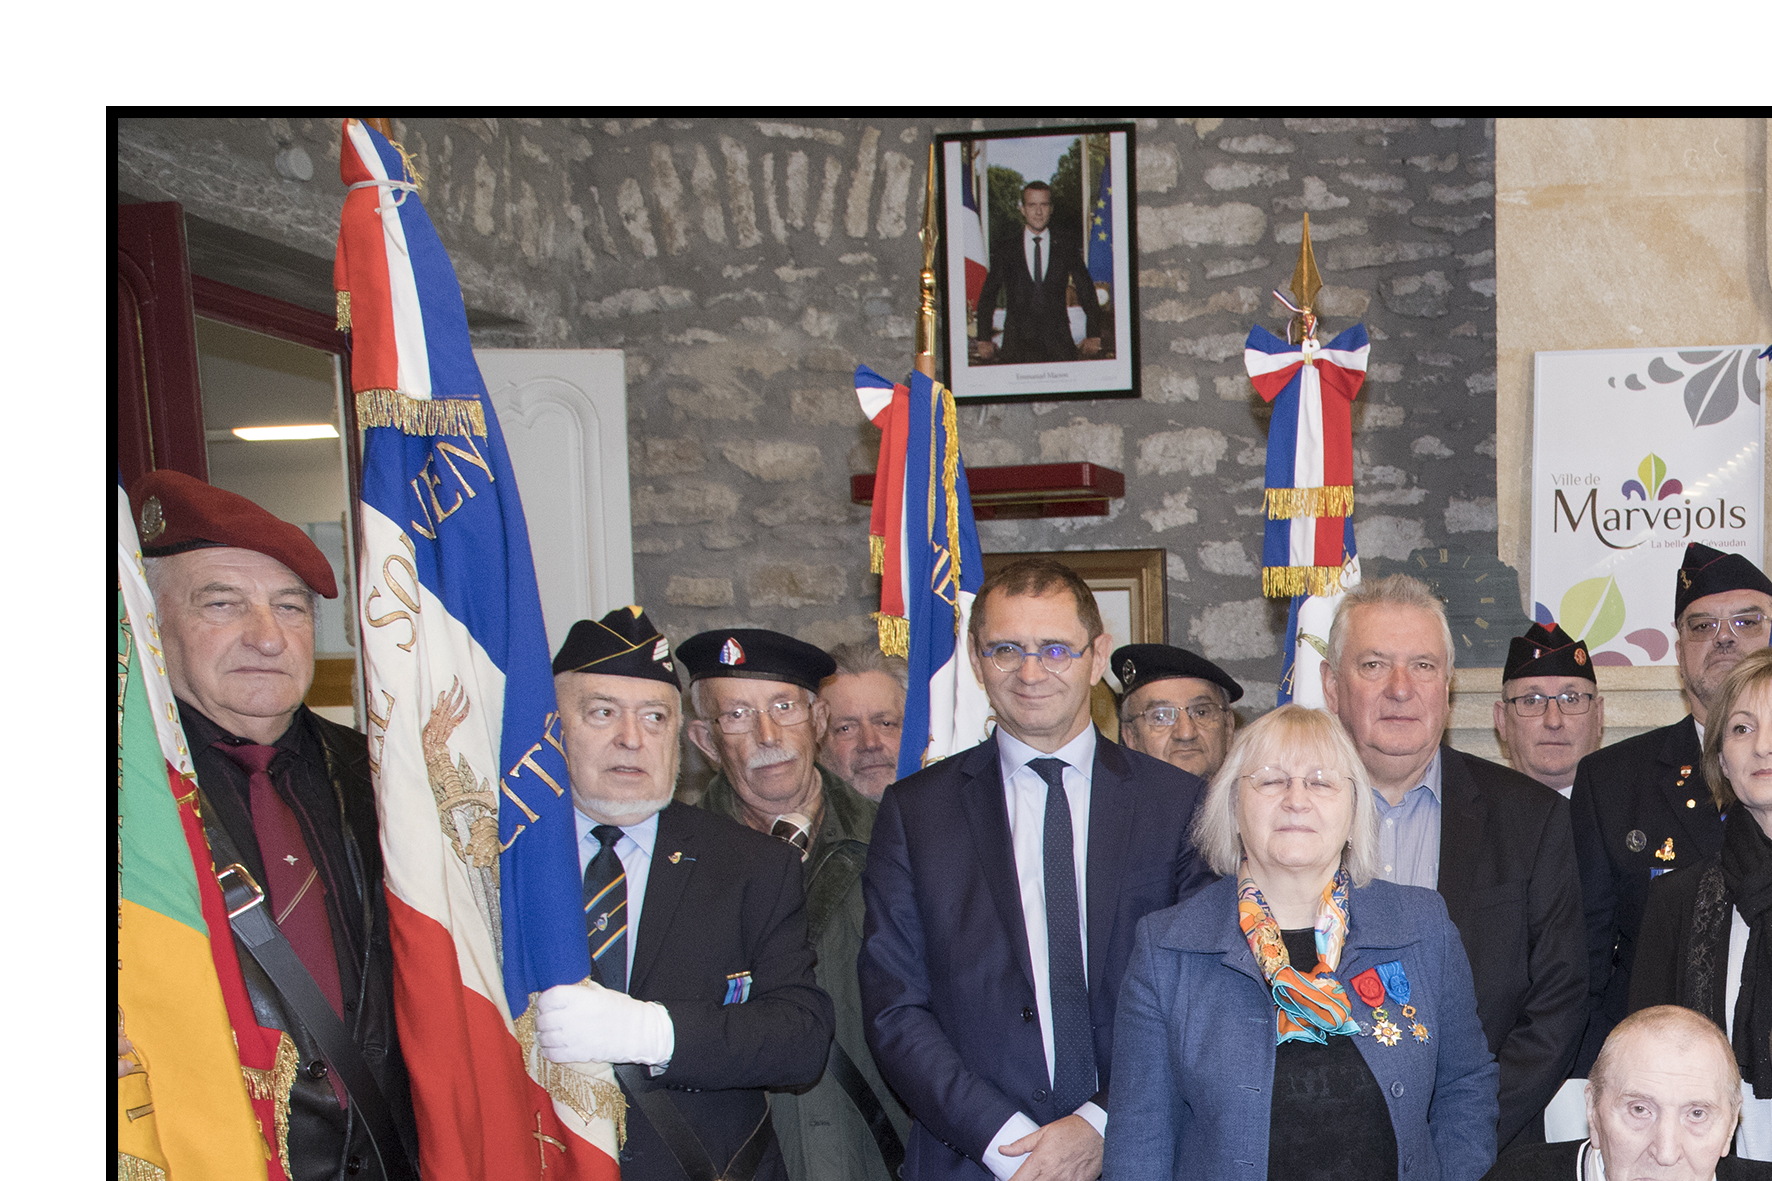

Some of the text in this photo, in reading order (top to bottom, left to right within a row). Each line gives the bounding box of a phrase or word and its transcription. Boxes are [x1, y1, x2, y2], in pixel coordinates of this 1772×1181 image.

[1551, 473, 1601, 486] Ville de
[1554, 488, 1747, 550] Marvejols
[1651, 540, 1662, 549] La
[1664, 540, 1686, 549] belle
[1701, 538, 1747, 548] Gévaudan
